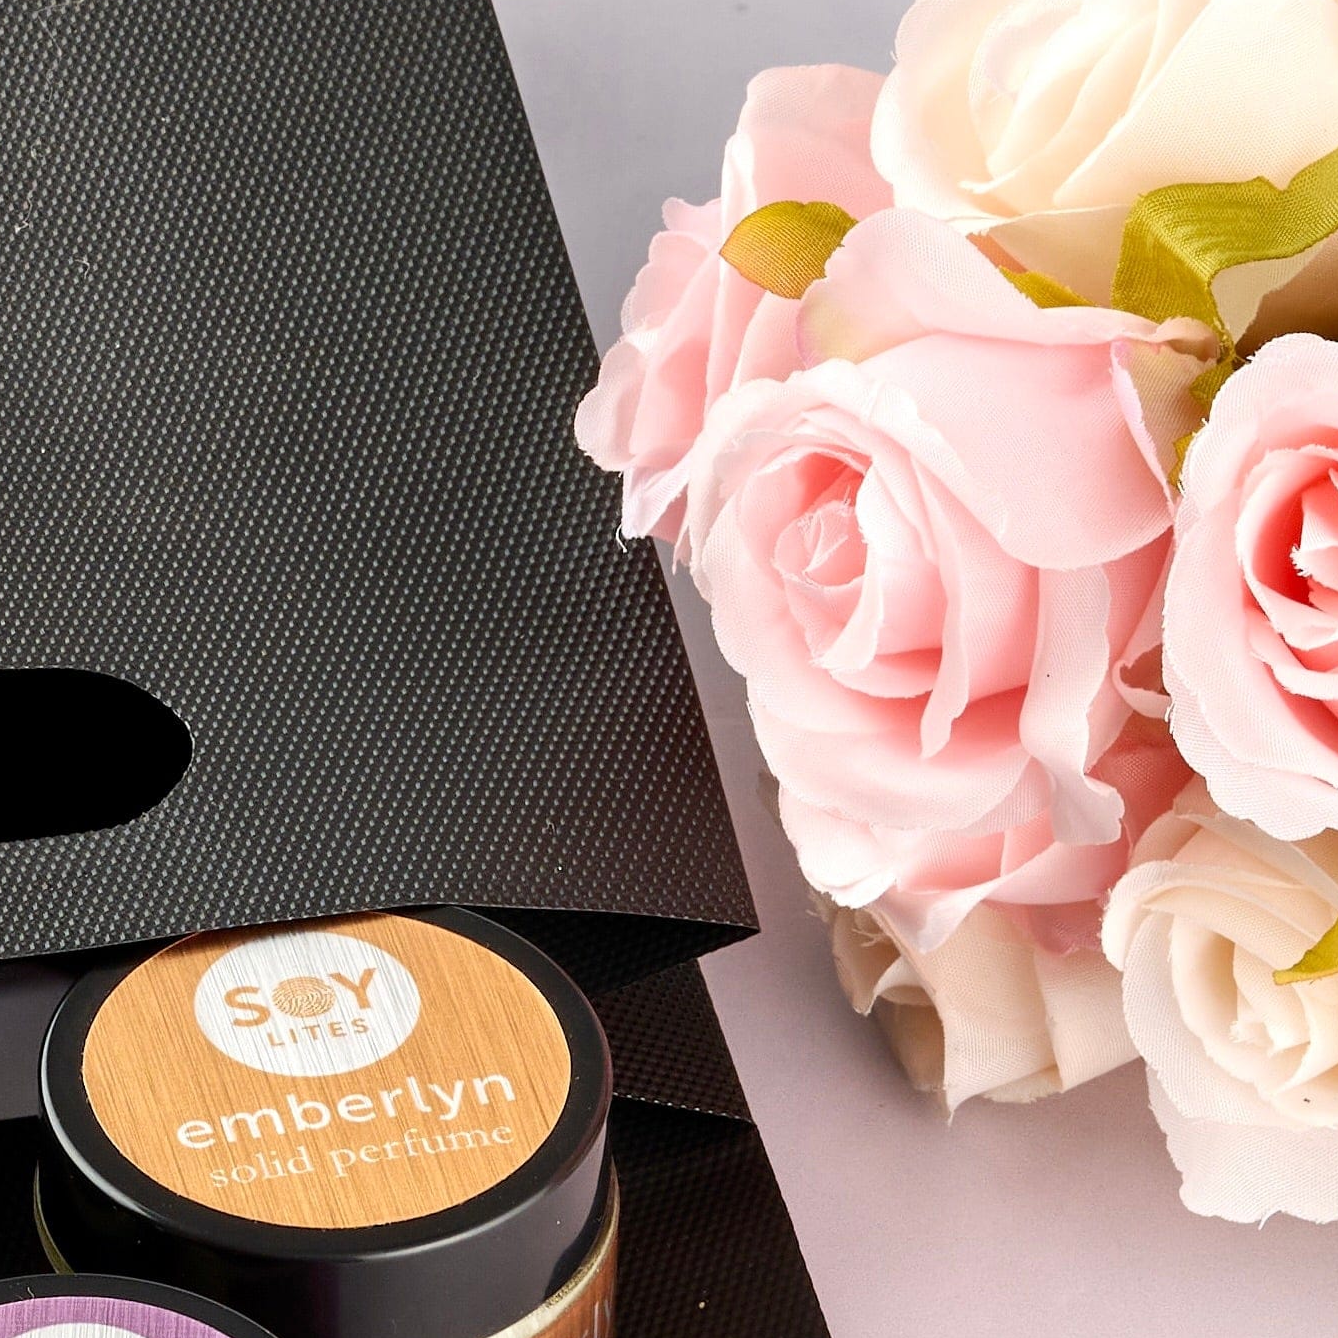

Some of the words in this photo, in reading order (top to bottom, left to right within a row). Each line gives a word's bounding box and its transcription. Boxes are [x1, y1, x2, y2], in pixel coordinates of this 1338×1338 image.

[223, 966, 378, 1028] SOY
[268, 1017, 370, 1048] LITES
[175, 1072, 517, 1150] emberlyn
[209, 1148, 314, 1188] solid
[326, 1121, 515, 1178] perfume
